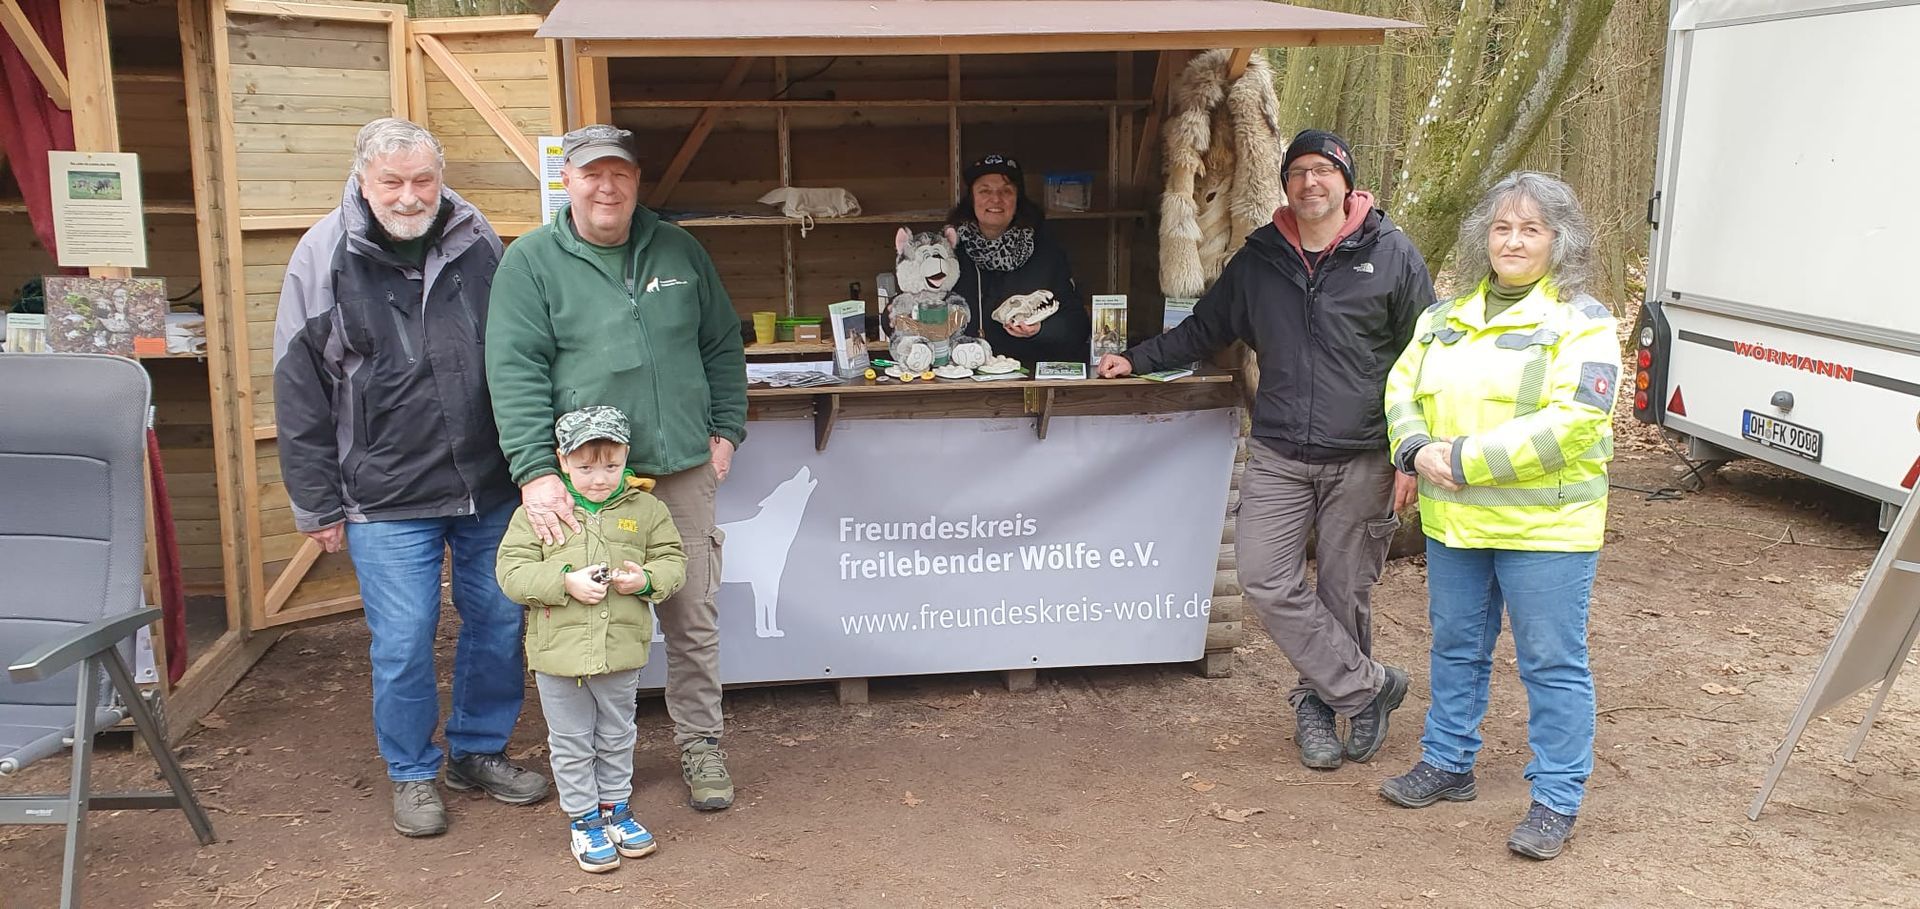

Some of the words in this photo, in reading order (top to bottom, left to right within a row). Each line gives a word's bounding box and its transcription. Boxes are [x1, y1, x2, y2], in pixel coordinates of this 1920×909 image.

[1733, 341, 1853, 382] WÖRMANN
[1750, 416, 1765, 437] OH
[1772, 423, 1788, 444] FK
[839, 513, 1037, 542] Freundeskreis
[839, 548, 1014, 580] freilebender
[1019, 543, 1101, 570] Wölfe
[1109, 541, 1159, 568] e.V.
[841, 592, 1211, 635] www.freundeskreis-wolf.de
